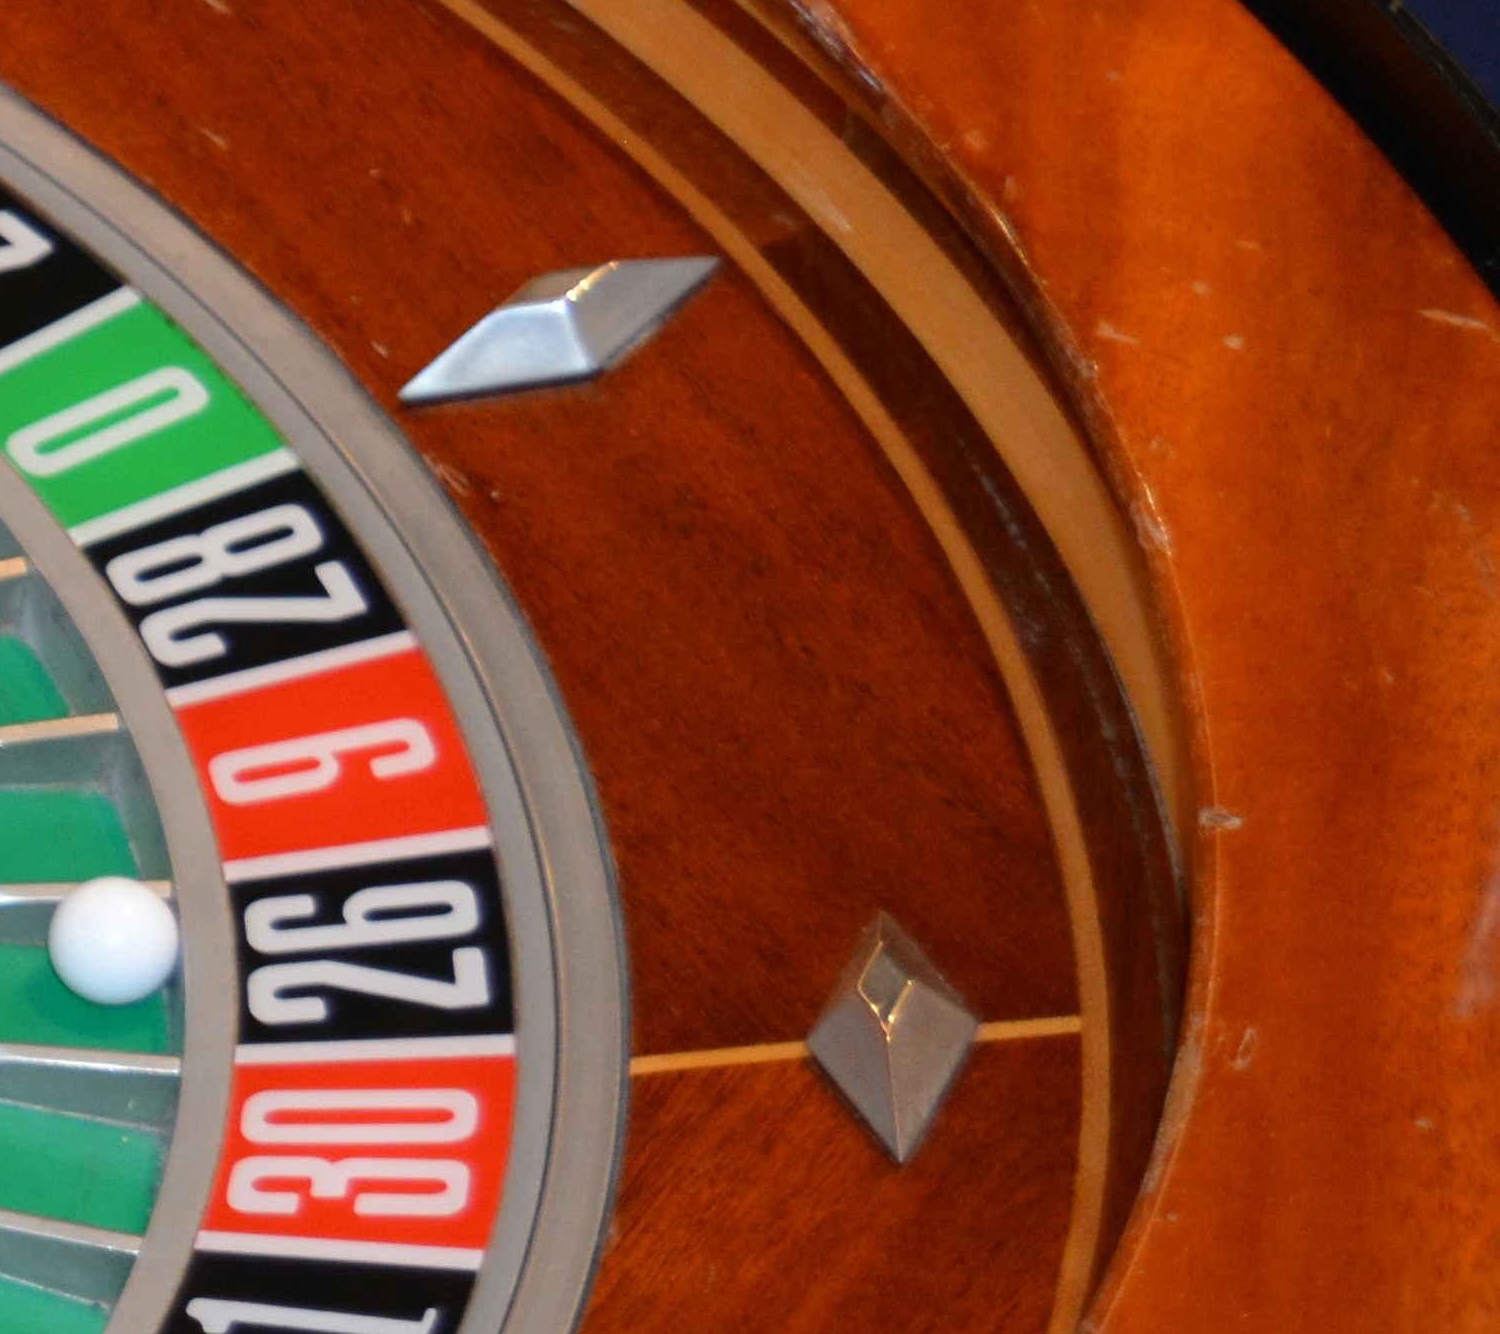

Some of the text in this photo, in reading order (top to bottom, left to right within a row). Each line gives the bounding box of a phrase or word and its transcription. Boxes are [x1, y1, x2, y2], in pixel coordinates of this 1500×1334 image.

[5, 365, 212, 479] 0
[105, 503, 368, 667] 28
[208, 717, 438, 805] 9
[243, 879, 491, 1025] 26
[225, 1087, 481, 1218] 30
